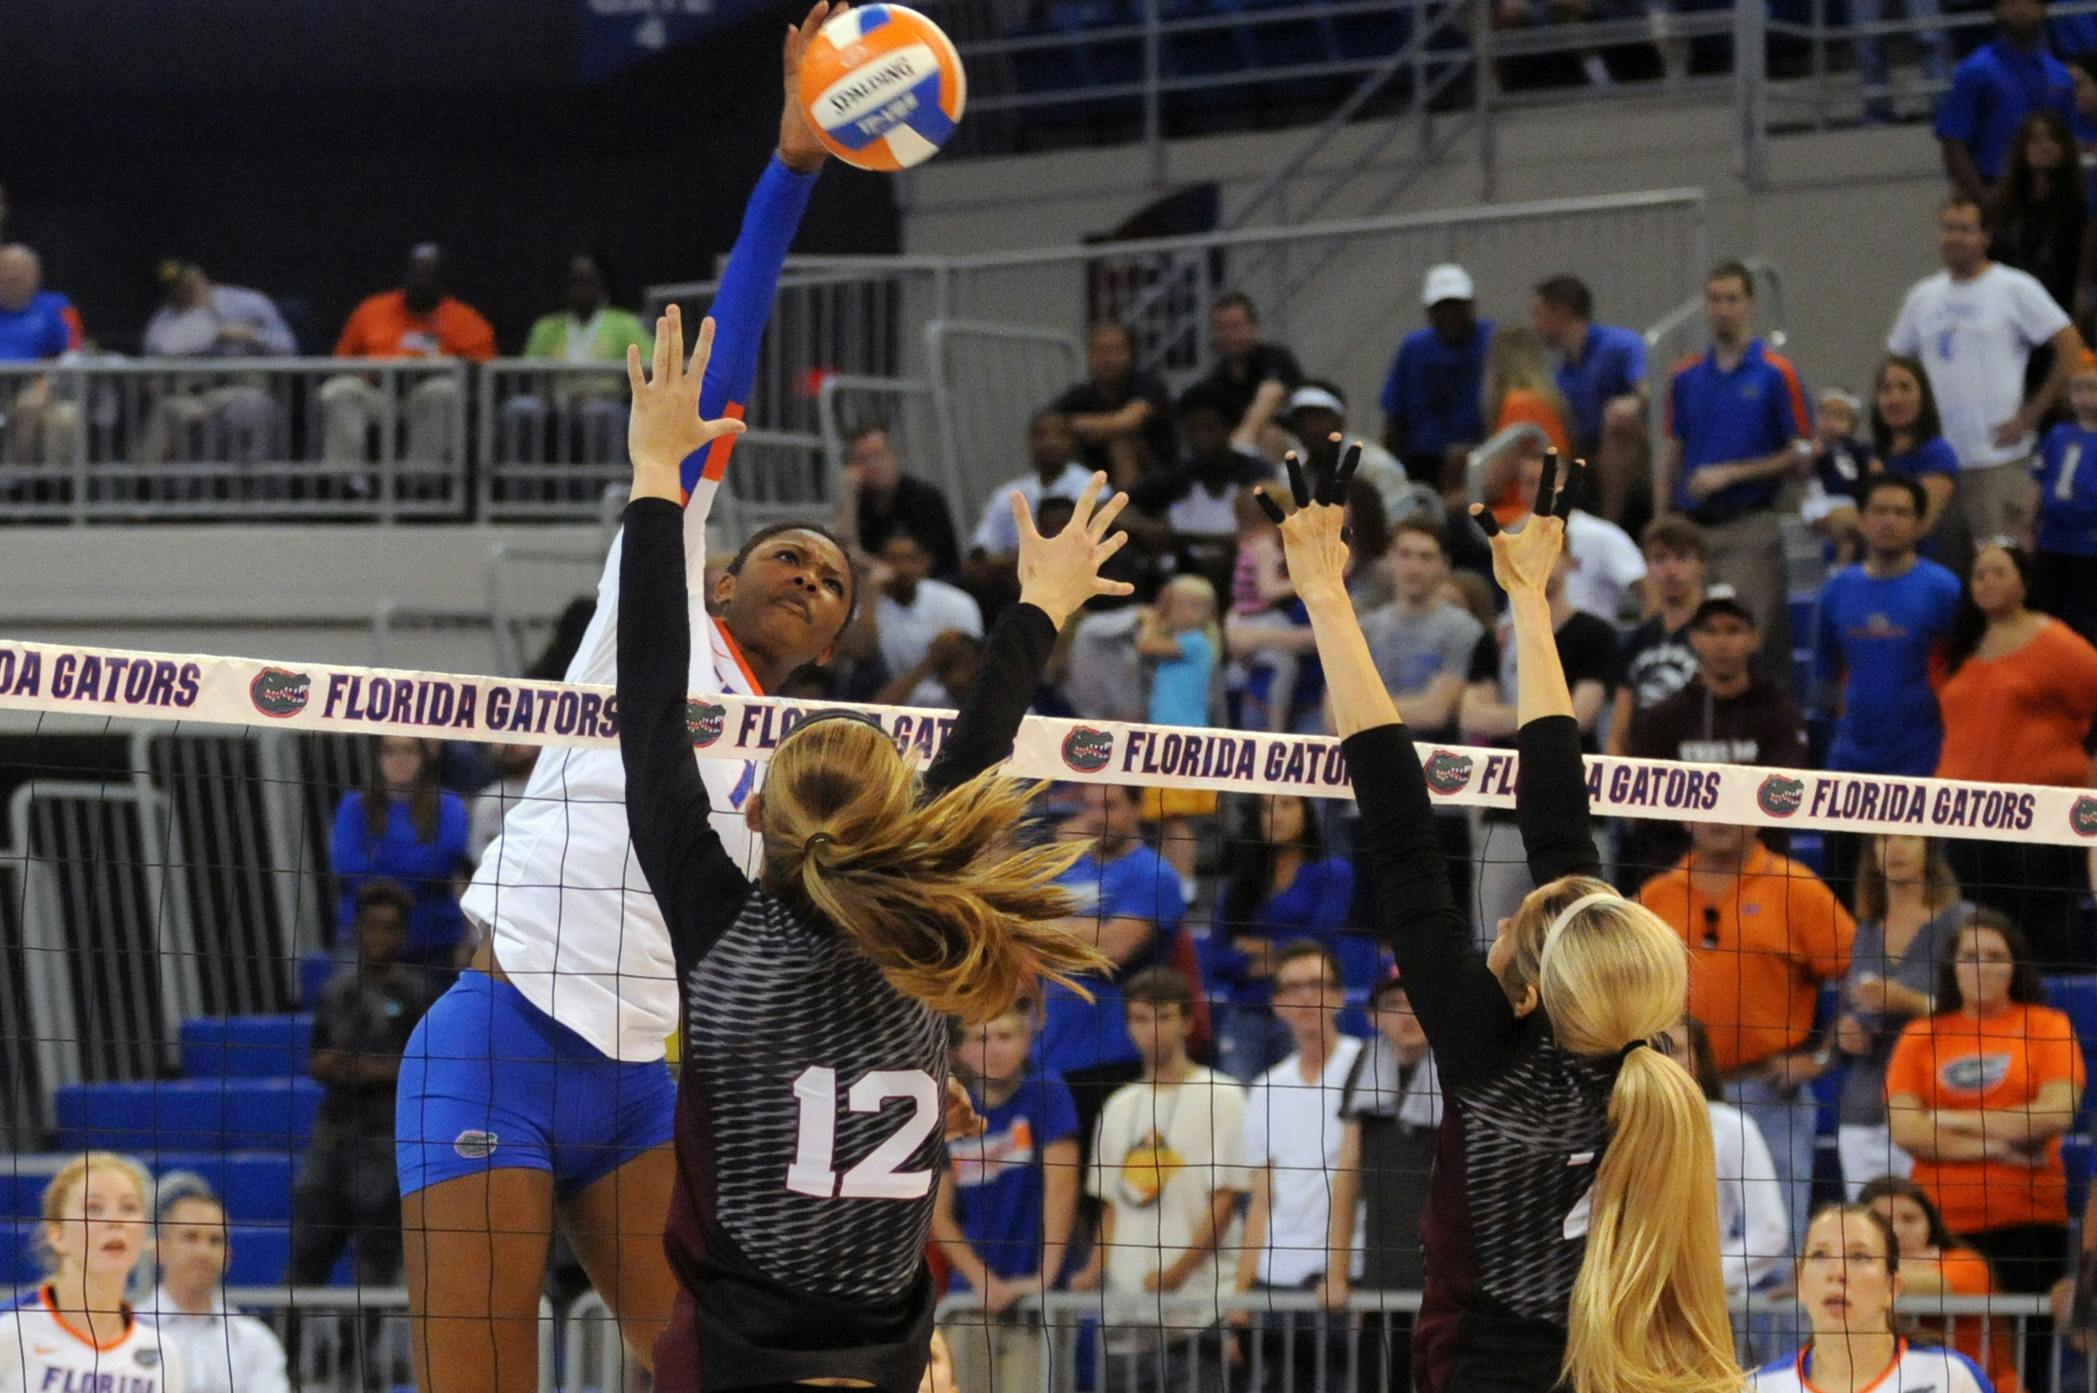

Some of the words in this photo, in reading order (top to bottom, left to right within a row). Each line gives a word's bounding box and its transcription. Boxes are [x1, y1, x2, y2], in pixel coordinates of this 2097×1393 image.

[51, 653, 201, 708] GATORS
[322, 673, 477, 728] FLORIDA
[485, 686, 619, 738] GATORS
[893, 715, 957, 760] GAT
[1121, 730, 1252, 780] FLORIDA
[1263, 741, 1349, 786] GATO
[1608, 764, 1721, 810] GATORS
[1808, 779, 1927, 823] FLORIDA
[1932, 787, 2036, 830] GATORS
[786, 1064, 940, 1200] 12
